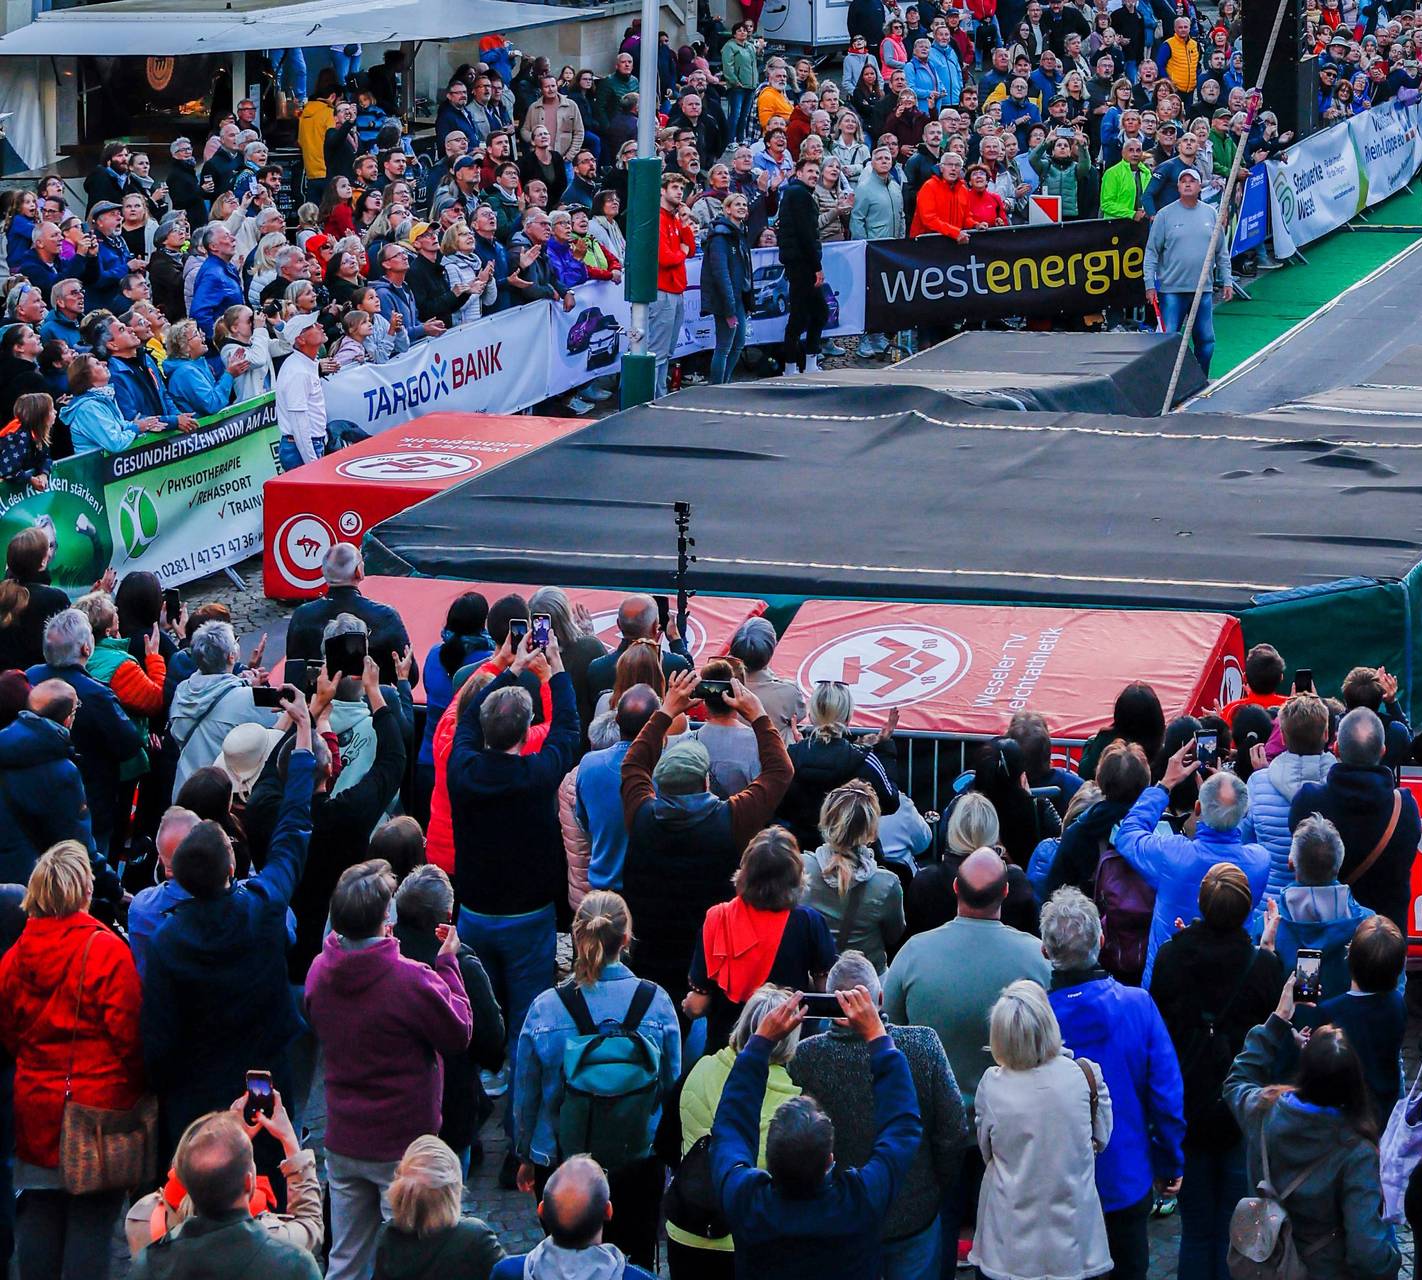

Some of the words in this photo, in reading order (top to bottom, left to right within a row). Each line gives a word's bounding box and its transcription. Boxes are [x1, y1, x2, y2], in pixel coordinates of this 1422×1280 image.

[1297, 192, 1315, 221] Wesel
[880, 236, 1144, 304] westenergie
[363, 370, 431, 422] TARGO
[451, 341, 503, 390] BANK
[246, 415, 261, 433] AM
[8, 491, 25, 507] den
[26, 474, 68, 498] Rken
[70, 483, 104, 515] stärken!
[167, 456, 242, 495] PHYSIOTHERAPIE
[197, 475, 252, 506] REHASPORT
[161, 557, 190, 578] 0281
[197, 549, 211, 565] 47
[211, 543, 226, 559] 57
[228, 538, 241, 552] 47
[241, 532, 254, 549] 36
[972, 655, 1017, 708] Weseler
[1002, 633, 1028, 649] TV
